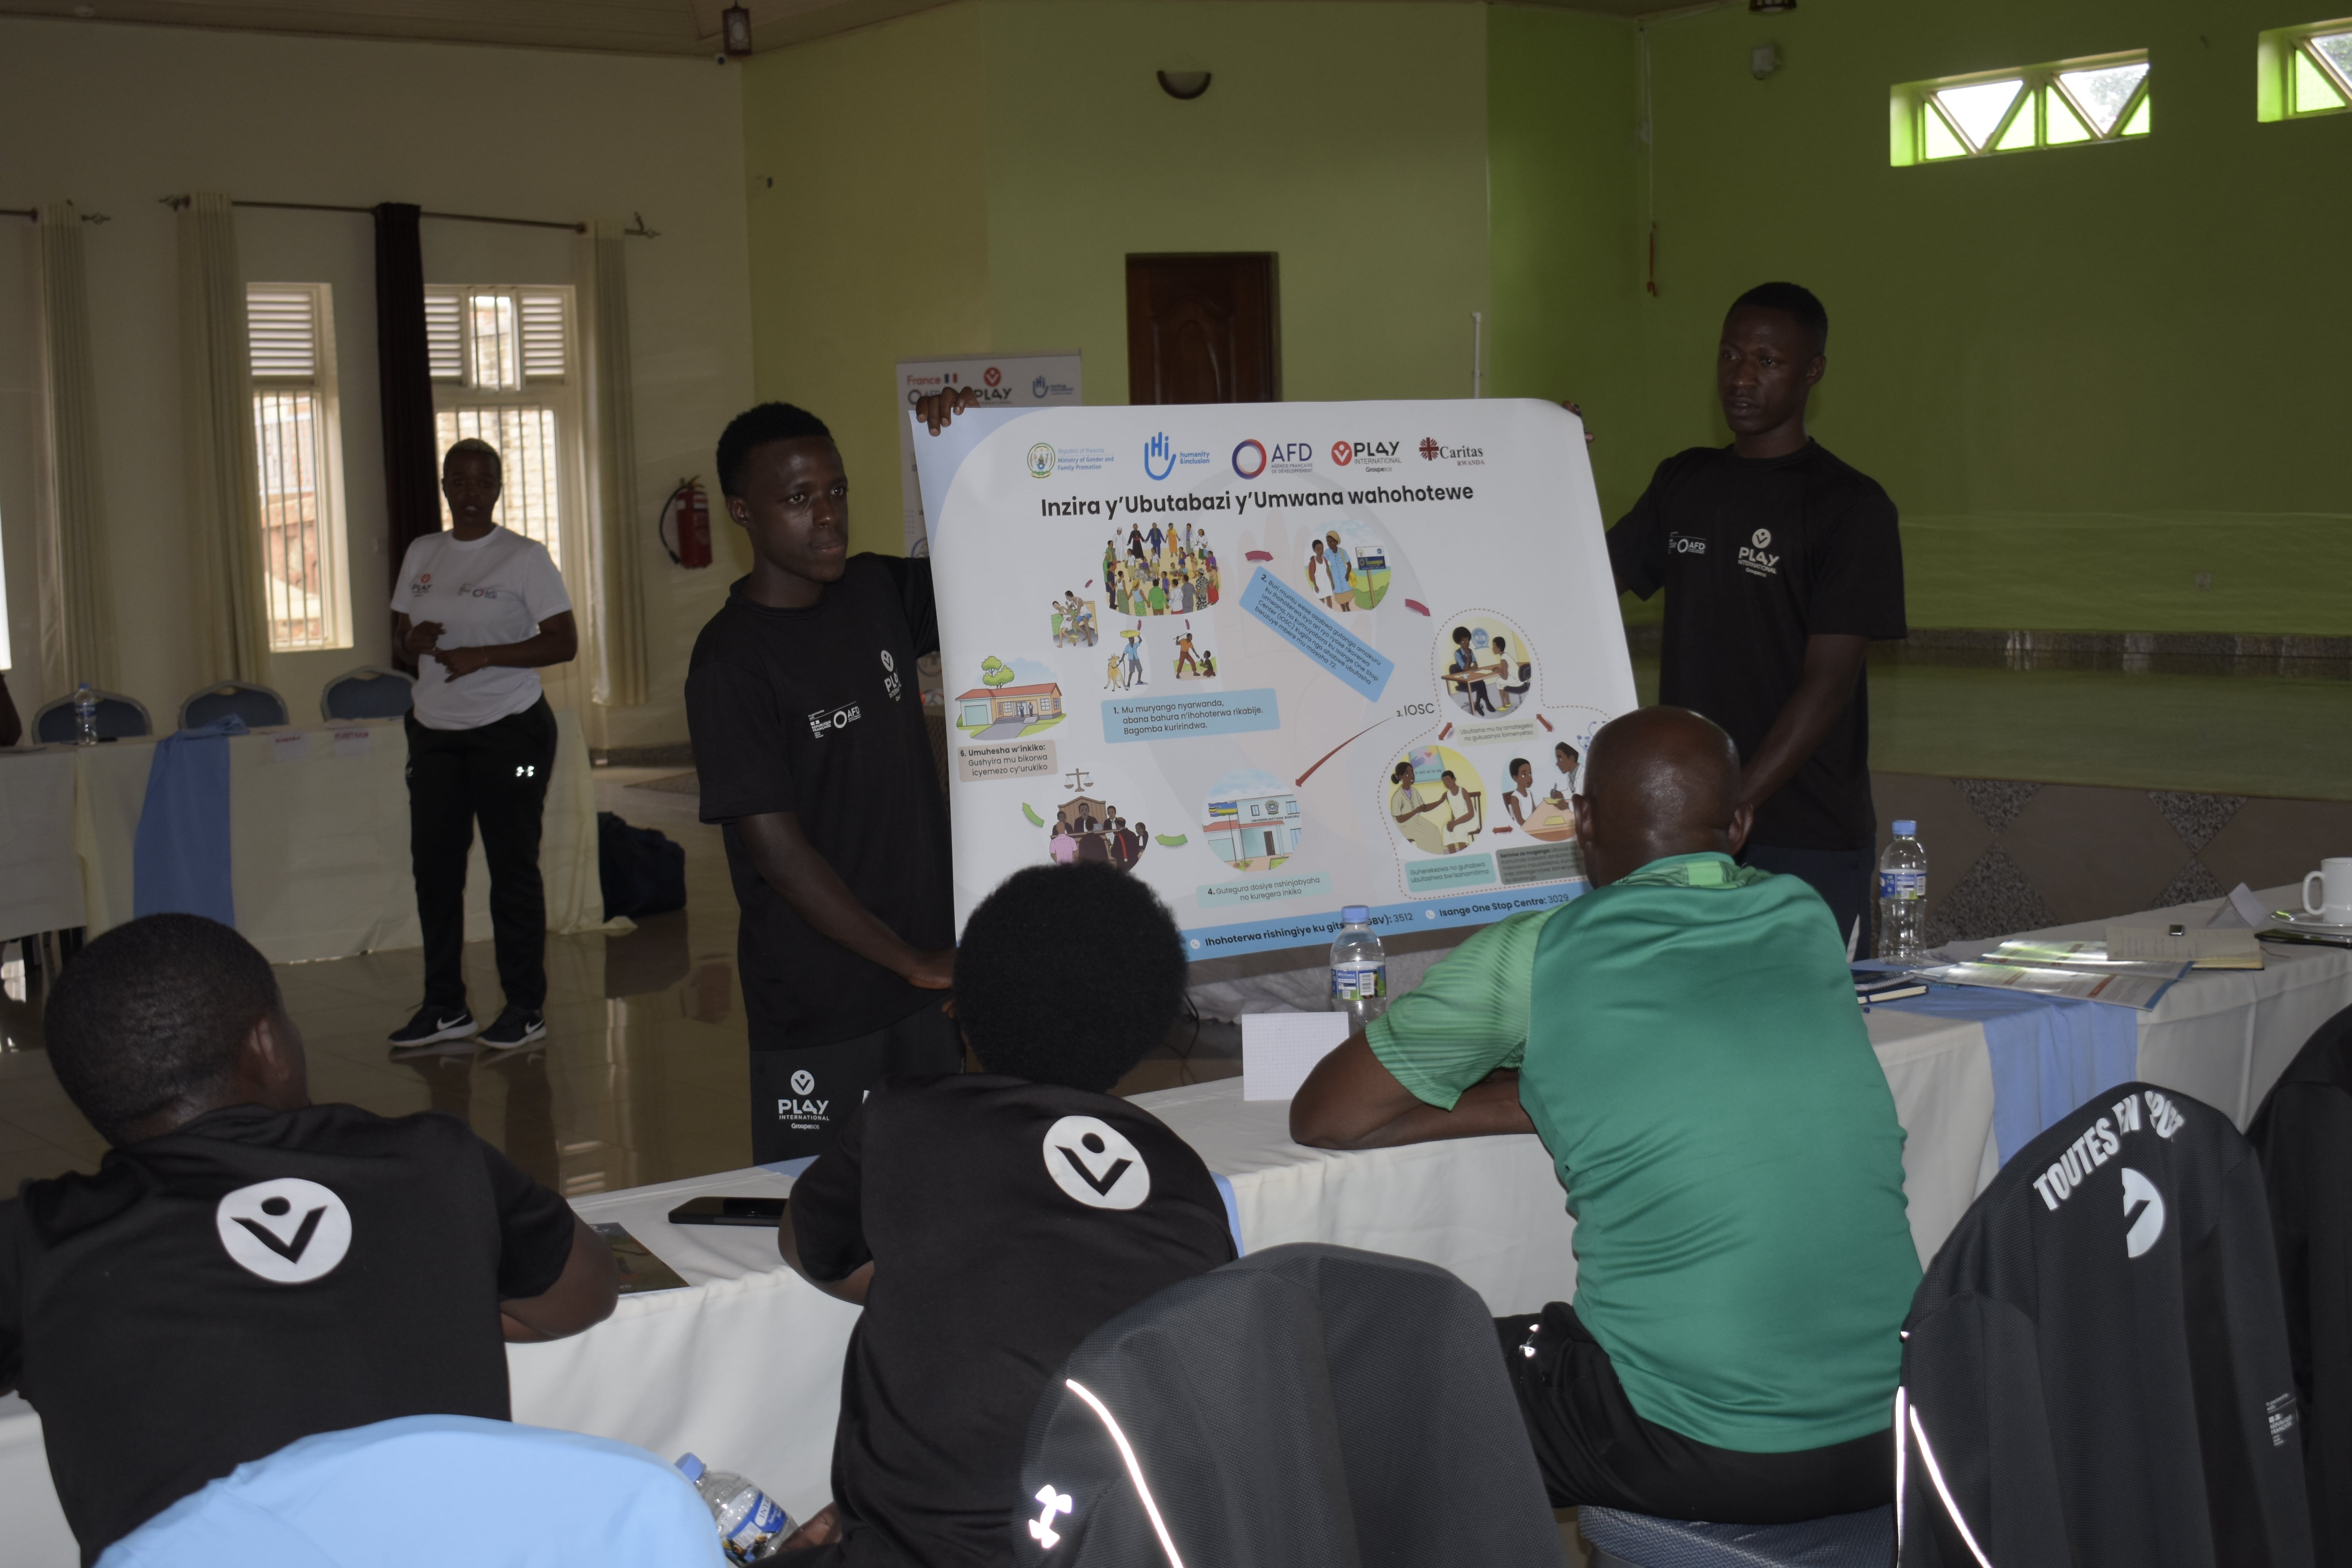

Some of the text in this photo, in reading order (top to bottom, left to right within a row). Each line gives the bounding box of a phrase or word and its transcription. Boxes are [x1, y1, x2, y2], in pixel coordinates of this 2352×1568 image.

[907, 374, 940, 385] France
[1151, 432, 1169, 461] Hi
[1271, 443, 1312, 463] AFD
[1354, 441, 1399, 457] PLAY
[1439, 445, 1483, 459] Caritas
[1042, 485, 1473, 520] Inzira y'Ubutabazi y'Umwana wahohotewe
[1688, 541, 1705, 550] AFD
[1738, 547, 1779, 566] PLAY
[1737, 559, 1777, 574] INTERNATIONAL
[1269, 581, 1279, 591] Buri
[1279, 590, 1297, 604] muntu
[1298, 603, 1311, 615] wese
[1312, 614, 1332, 631] asabwa
[1333, 630, 1356, 648] gutanga
[1356, 647, 1381, 665] amakuru
[1272, 592, 1301, 617] ihohoterwa
[1302, 614, 1312, 625] iryo
[1330, 636, 1345, 648] ryose
[1345, 647, 1370, 666] rikorerwa
[1255, 606, 1278, 626] bwuzuye
[1278, 625, 1296, 639] mbere
[1296, 638, 1306, 646] mu
[1306, 645, 1328, 663] masaha
[1262, 594, 1285, 615] umwana,
[1294, 618, 1327, 645] kumuyobora
[1335, 648, 1354, 664] Isange
[1354, 662, 1365, 671] One
[1366, 670, 1378, 681] Stop
[1258, 600, 1371, 685] Center (IOSC) kugira ngo ahabwe ubufasha
[848, 706, 860, 718] AFD
[1136, 704, 1176, 713] muryango
[1178, 700, 1224, 711] nyarwanda,
[1404, 703, 1435, 716] IOSC
[1123, 716, 1149, 724] abana
[1151, 713, 1179, 722] bahura
[1233, 707, 1263, 716] rikabije.
[1124, 722, 1207, 736] Bagomba kuririndwa.
[1472, 733, 1501, 742] gukusanya
[969, 747, 1010, 756] Umuhesha
[968, 758, 1002, 767] Gushyira
[972, 768, 1008, 778] icyemezo
[1410, 866, 1448, 875] Guherekezwa
[1458, 862, 1485, 871] guhabwa
[1216, 884, 1249, 894] Gutegura
[1250, 882, 1272, 891] dosiye
[1274, 877, 1320, 889] nshinjabyaha
[1411, 874, 1443, 883] ubufashwa
[1250, 890, 1281, 900] kuregera
[1439, 894, 1568, 918] Isange One Stop Centre: 3029
[1205, 913, 1414, 946] Ihohoterwa rishingiye ku gits GBV): 3512
[778, 1099, 829, 1114] PLAY
[2033, 1118, 2119, 1210] TOUTES
[2112, 1094, 2140, 1136] EN
[759, 1499, 770, 1518] INYA
